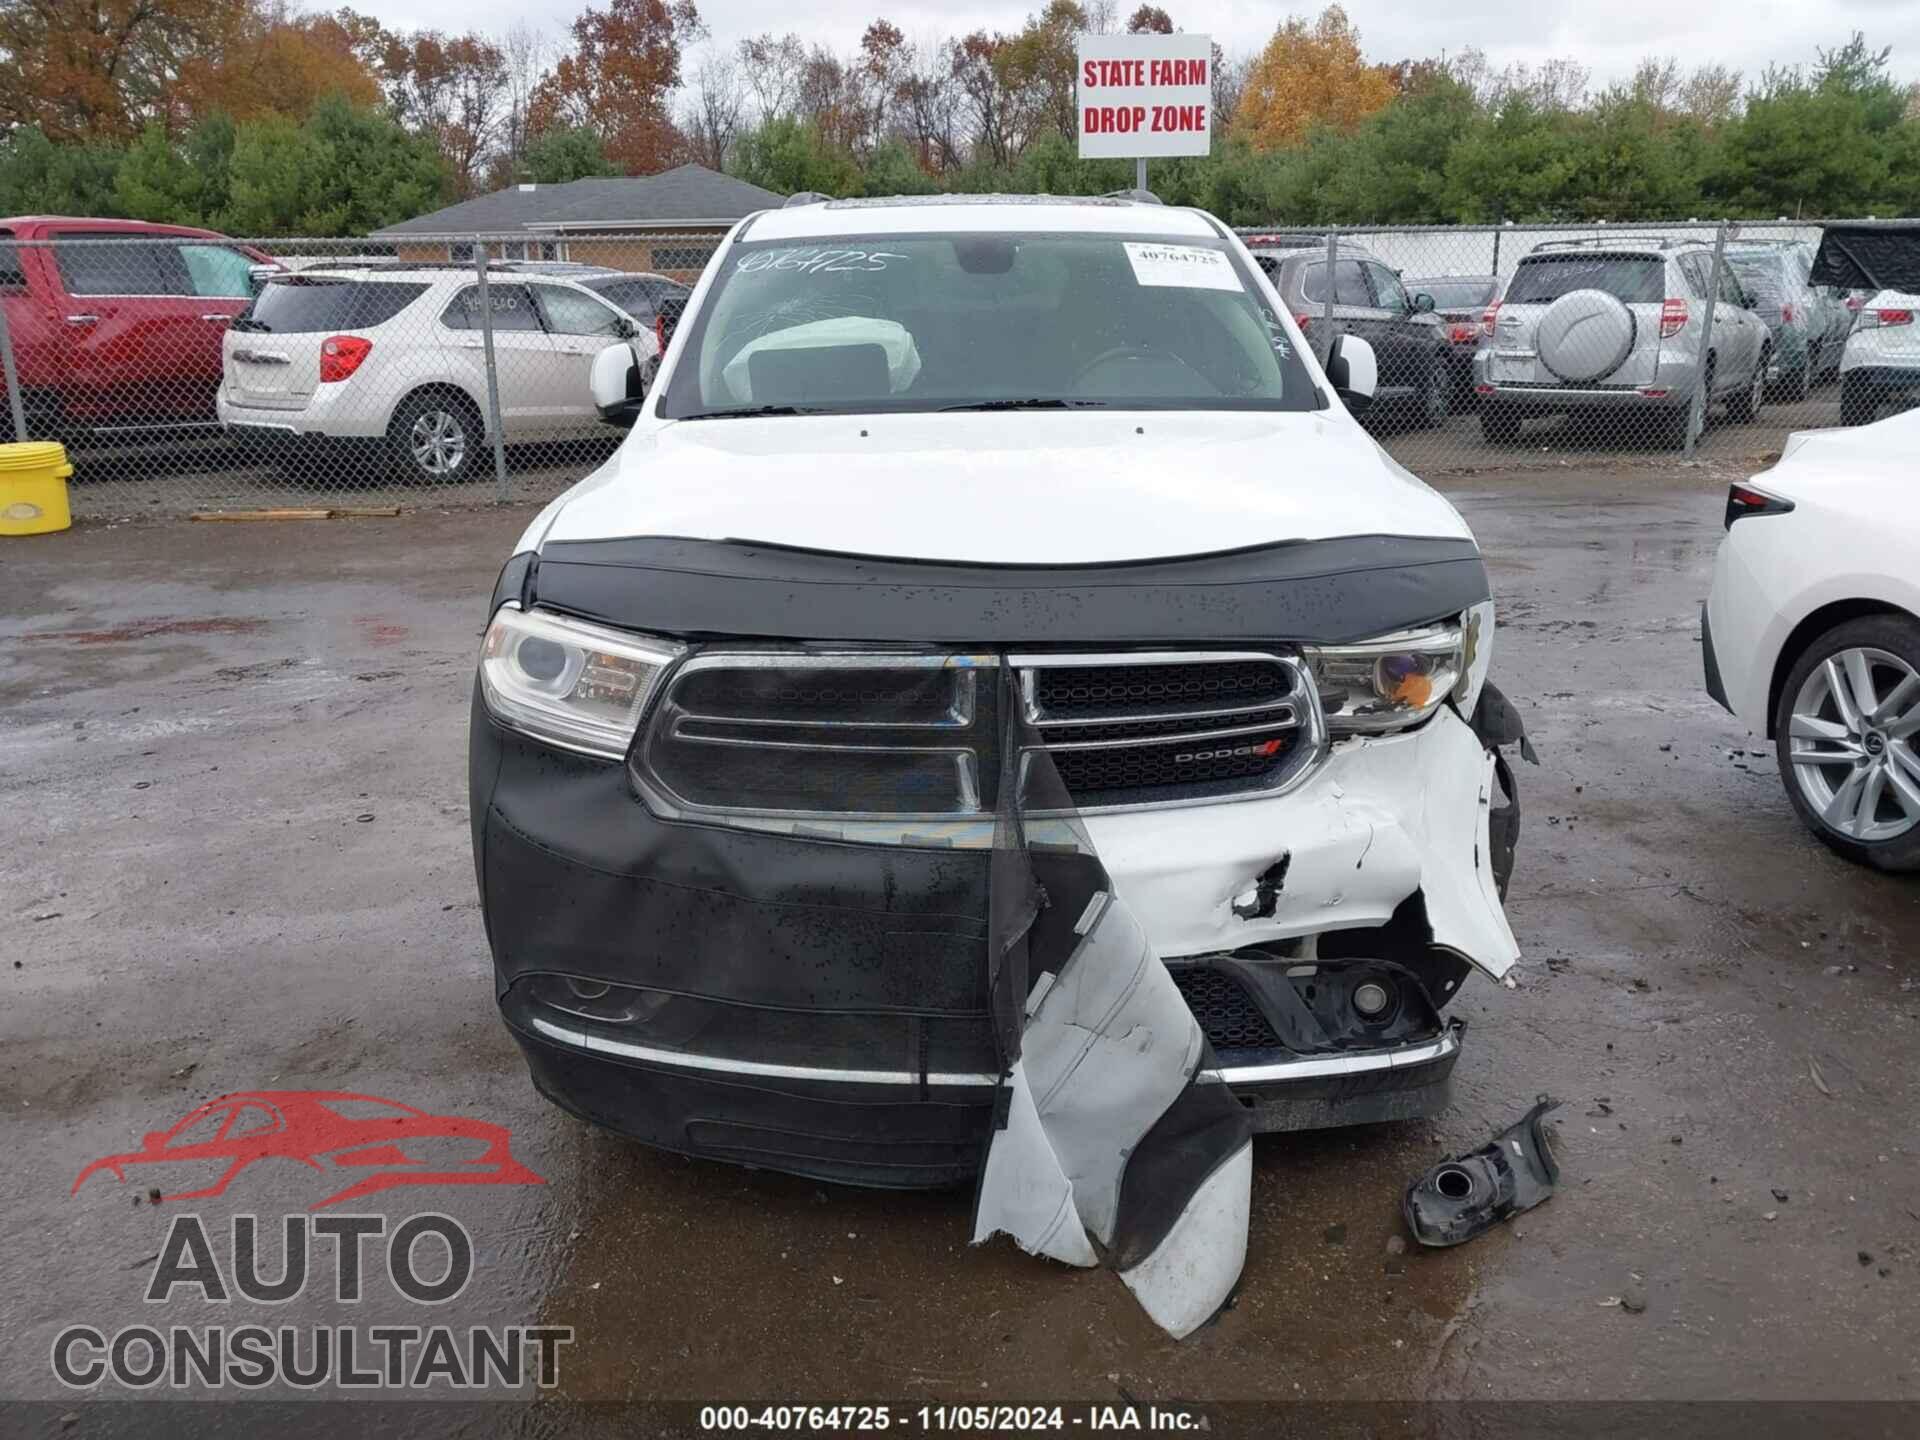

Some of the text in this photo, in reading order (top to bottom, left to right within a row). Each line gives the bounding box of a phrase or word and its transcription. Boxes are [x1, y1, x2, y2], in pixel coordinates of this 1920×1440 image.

[1084, 59, 1207, 88] STATE FARM
[1084, 105, 1206, 133] DROP ZONE
[1138, 250, 1220, 265] 40764725
[1175, 745, 1266, 762] DODGE
